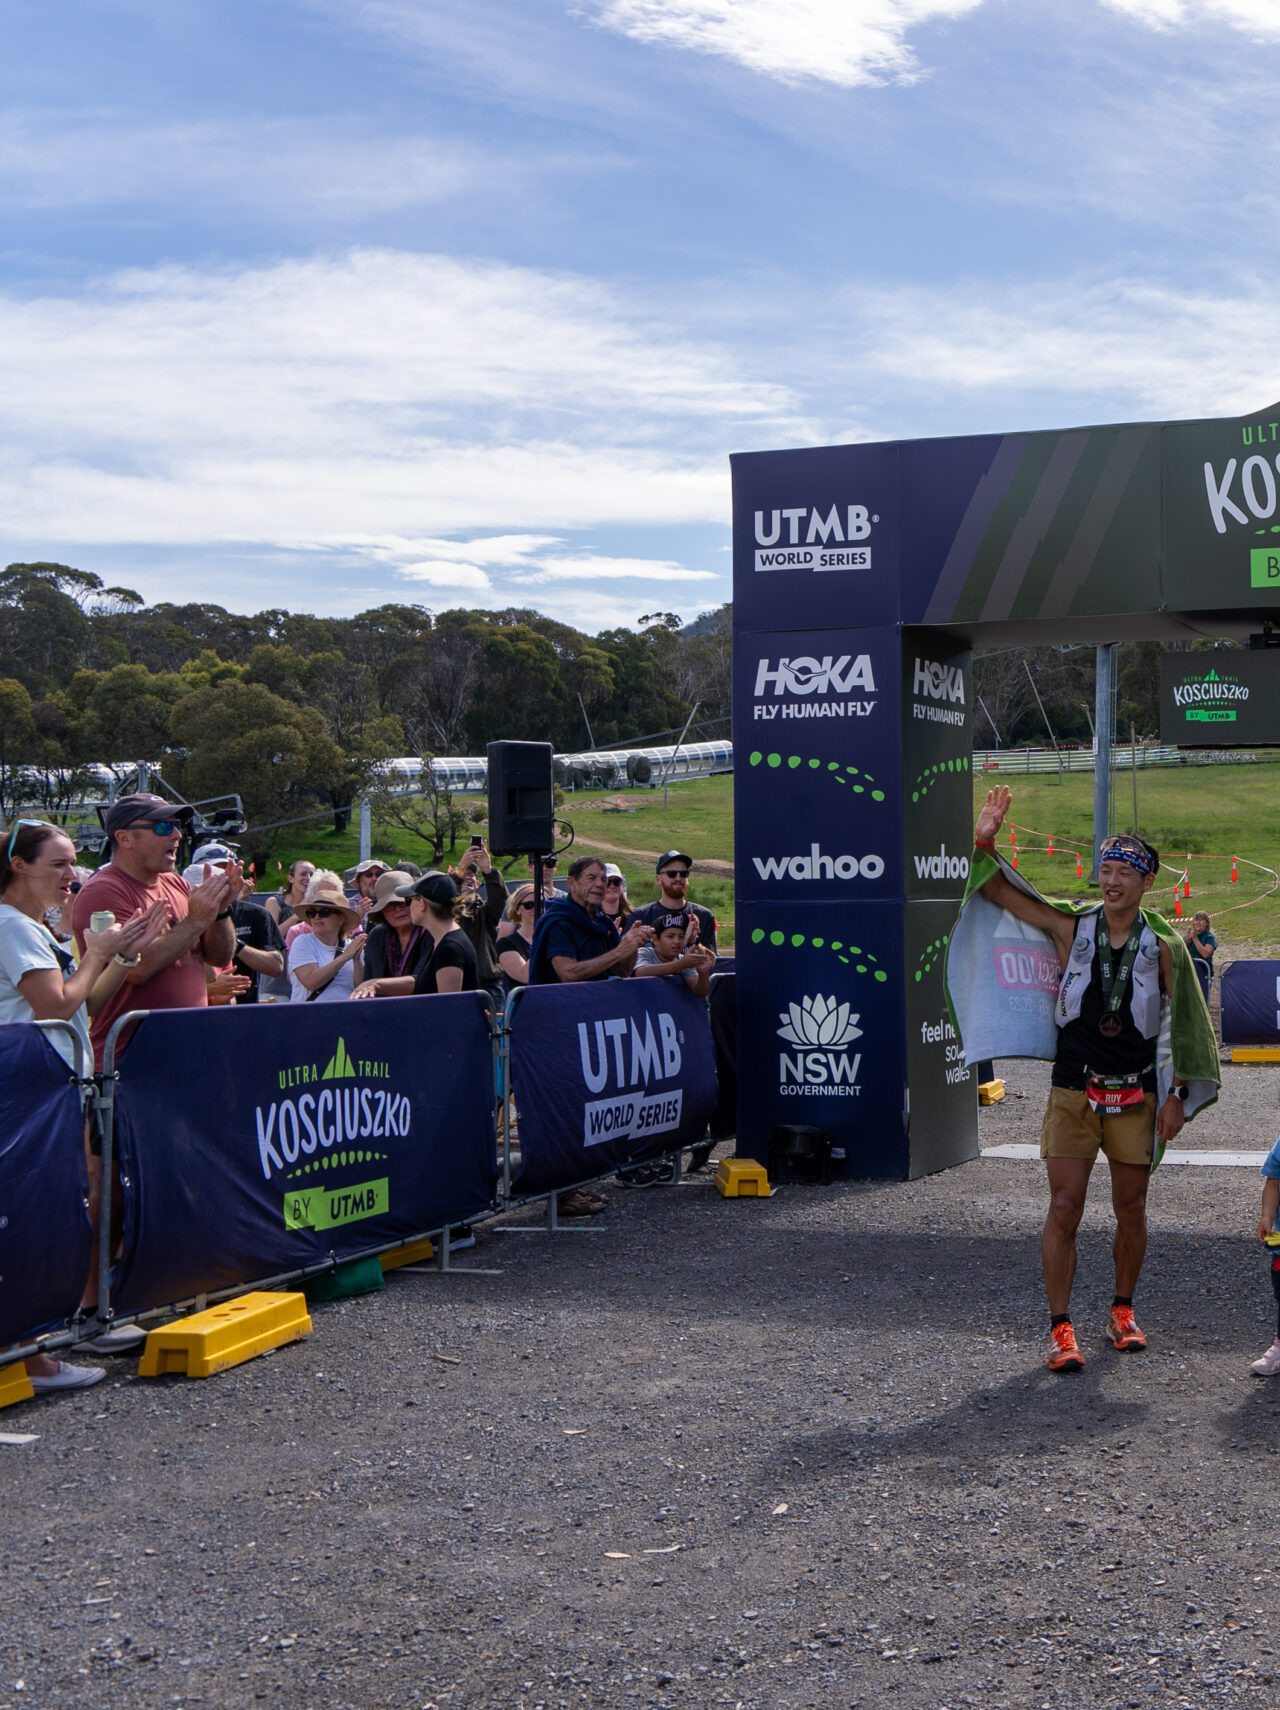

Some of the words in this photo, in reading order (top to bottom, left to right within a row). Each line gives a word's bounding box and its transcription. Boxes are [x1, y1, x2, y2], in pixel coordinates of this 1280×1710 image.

[760, 551, 813, 567] WORLD
[819, 551, 867, 567] SERIES
[754, 654, 876, 696] HOKA
[913, 658, 965, 704] HOKA
[1173, 683, 1249, 706] KOSCIUSZKO
[753, 705, 779, 720] FLY
[782, 702, 845, 719] HUMAN
[847, 701, 875, 716] FLY
[913, 703, 926, 719] FLY
[927, 706, 954, 725] HUMAN
[954, 711, 965, 726] FLY
[752, 843, 885, 880] wahoo
[913, 844, 969, 879] wahoo
[665, 913, 683, 927] Buff
[921, 1019, 944, 1043] feel
[279, 1064, 318, 1089] ULTRA
[358, 1060, 390, 1078] TRAIL
[780, 1053, 861, 1083] NSW
[780, 1085, 861, 1096] GOVERNMENT
[1105, 1093, 1122, 1103] RUY
[590, 1103, 634, 1136] WORLD
[637, 1099, 678, 1130] SERIES
[256, 1087, 411, 1179] KOSCIUSZKO
[293, 1196, 311, 1221] BY
